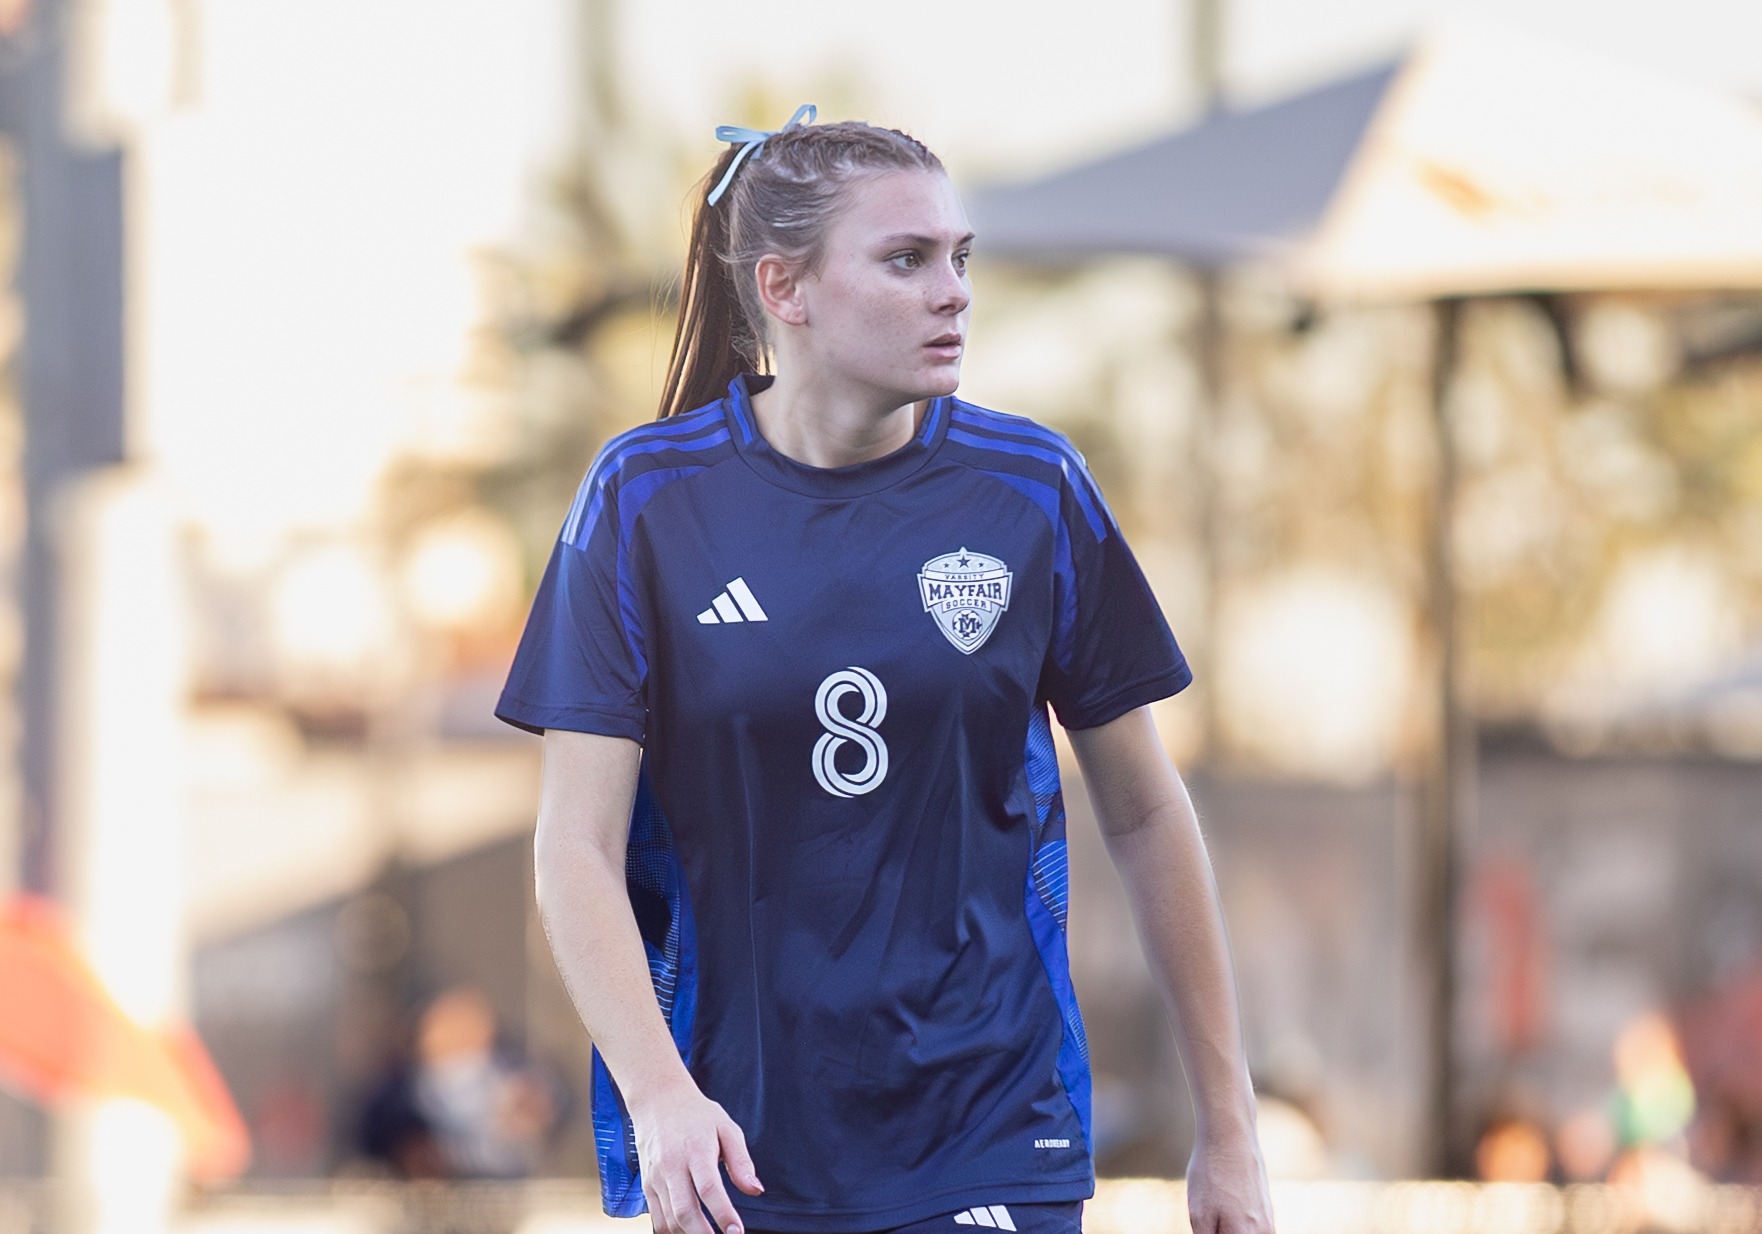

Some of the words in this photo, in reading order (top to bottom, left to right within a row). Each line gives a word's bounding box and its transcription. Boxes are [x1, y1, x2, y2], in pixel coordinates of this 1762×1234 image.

[928, 582, 1002, 601] MAYFAIR
[945, 599, 987, 609] SOCCER
[958, 617, 977, 634] M
[812, 666, 889, 798] 8
